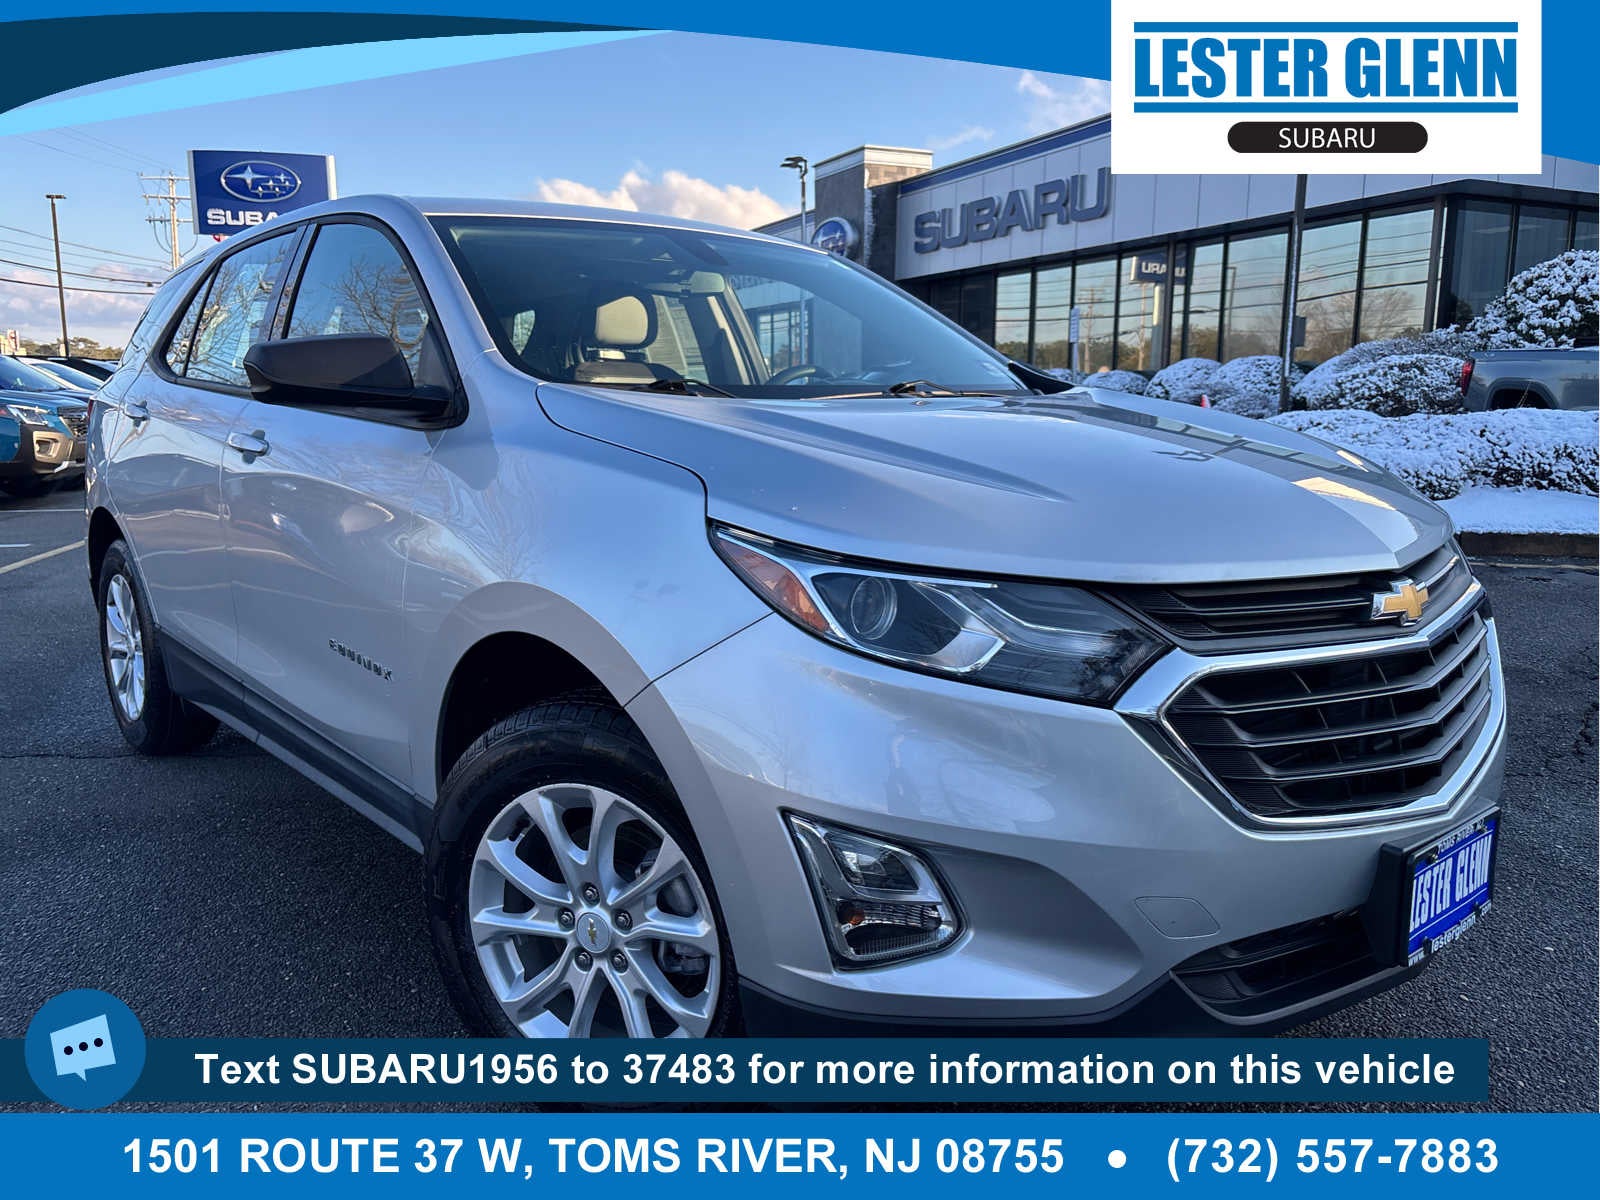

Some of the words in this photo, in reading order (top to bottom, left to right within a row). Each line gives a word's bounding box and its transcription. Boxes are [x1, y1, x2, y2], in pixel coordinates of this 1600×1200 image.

[914, 167, 1110, 254] SUBARU
[1409, 856, 1453, 933] LESTER
[1455, 833, 1492, 902] GLENN
